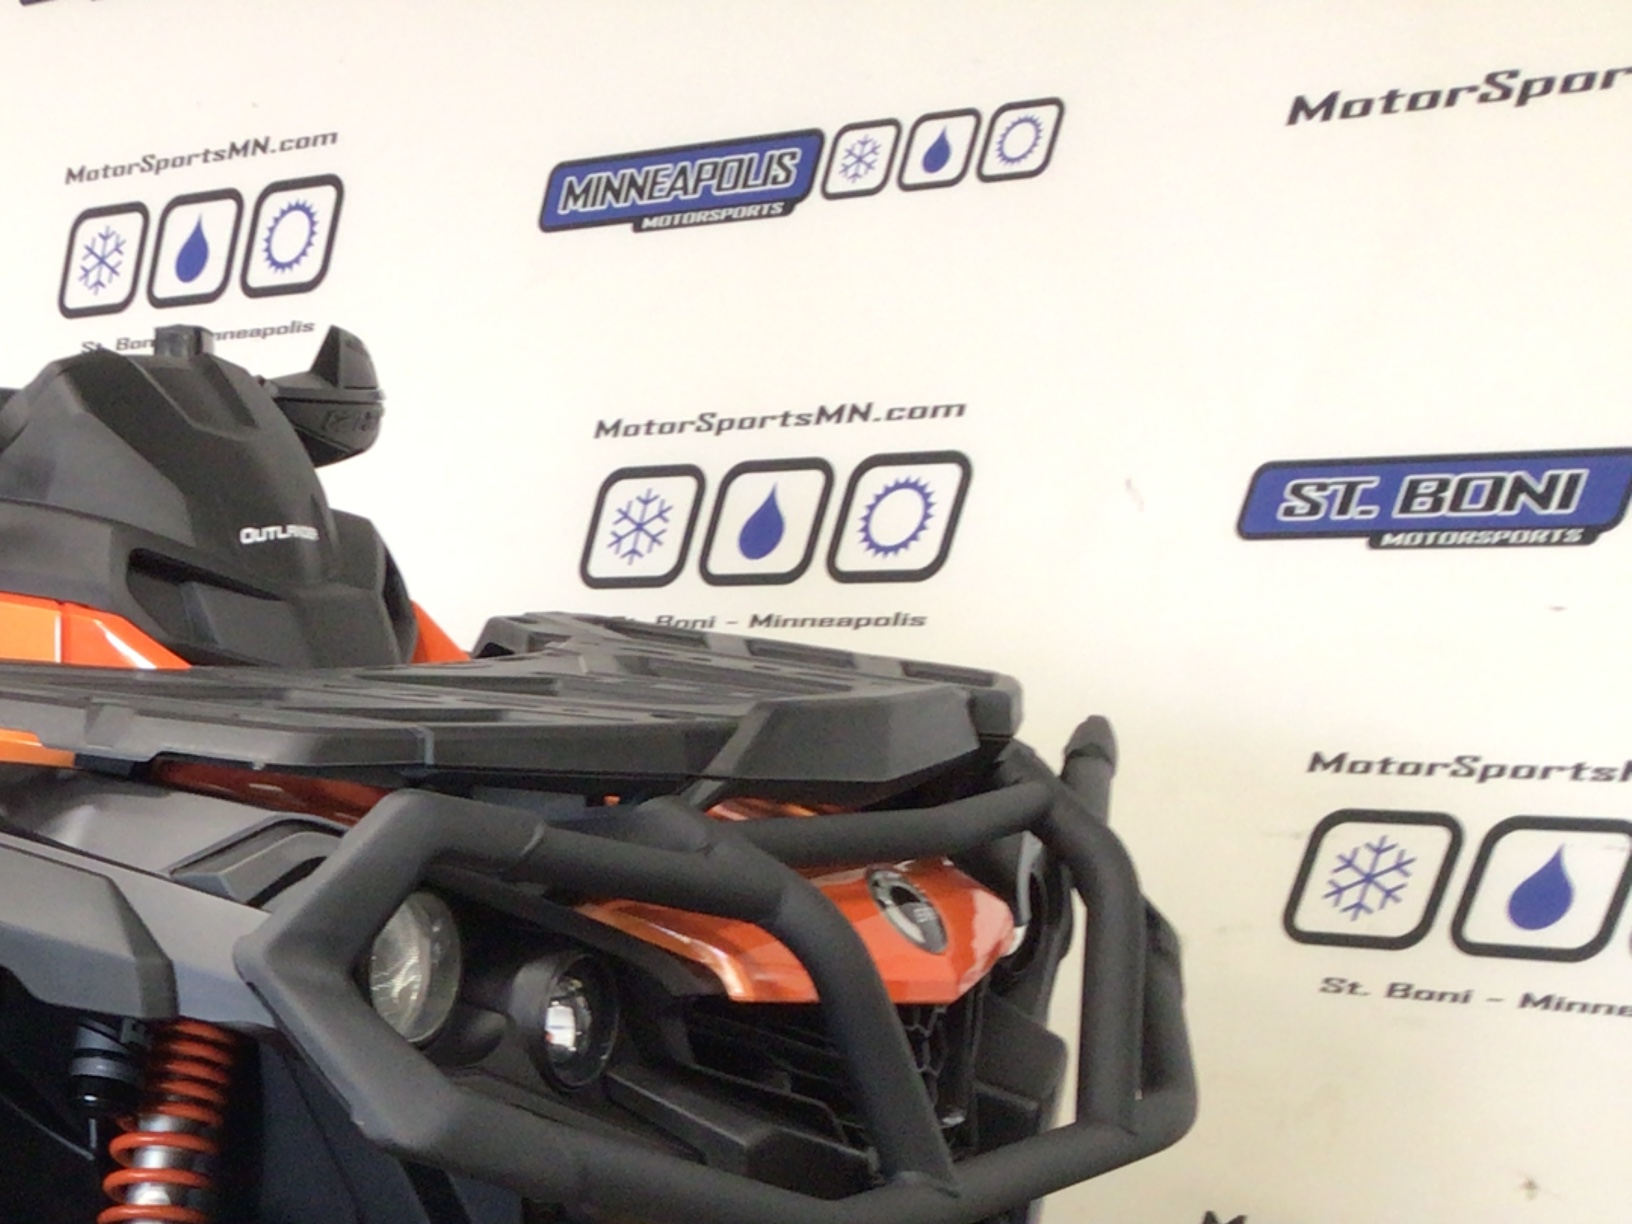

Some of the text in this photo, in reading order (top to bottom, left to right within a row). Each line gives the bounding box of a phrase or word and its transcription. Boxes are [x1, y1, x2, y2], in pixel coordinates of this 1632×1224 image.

[65, 131, 339, 186] MotorSportsMN.com
[557, 148, 802, 214] MINNEAPOLIS
[641, 201, 785, 229] MOTORSPORTS
[115, 336, 156, 351] Bon
[212, 320, 315, 342] nneapolis
[593, 402, 967, 439] MotorSportsMN.com
[1277, 469, 1589, 521] ST. BONI
[1380, 528, 1584, 547] MOTORSPORTS
[748, 611, 928, 631] Minneapolis
[1319, 976, 1371, 997] St.
[1384, 981, 1474, 1005] Boni
